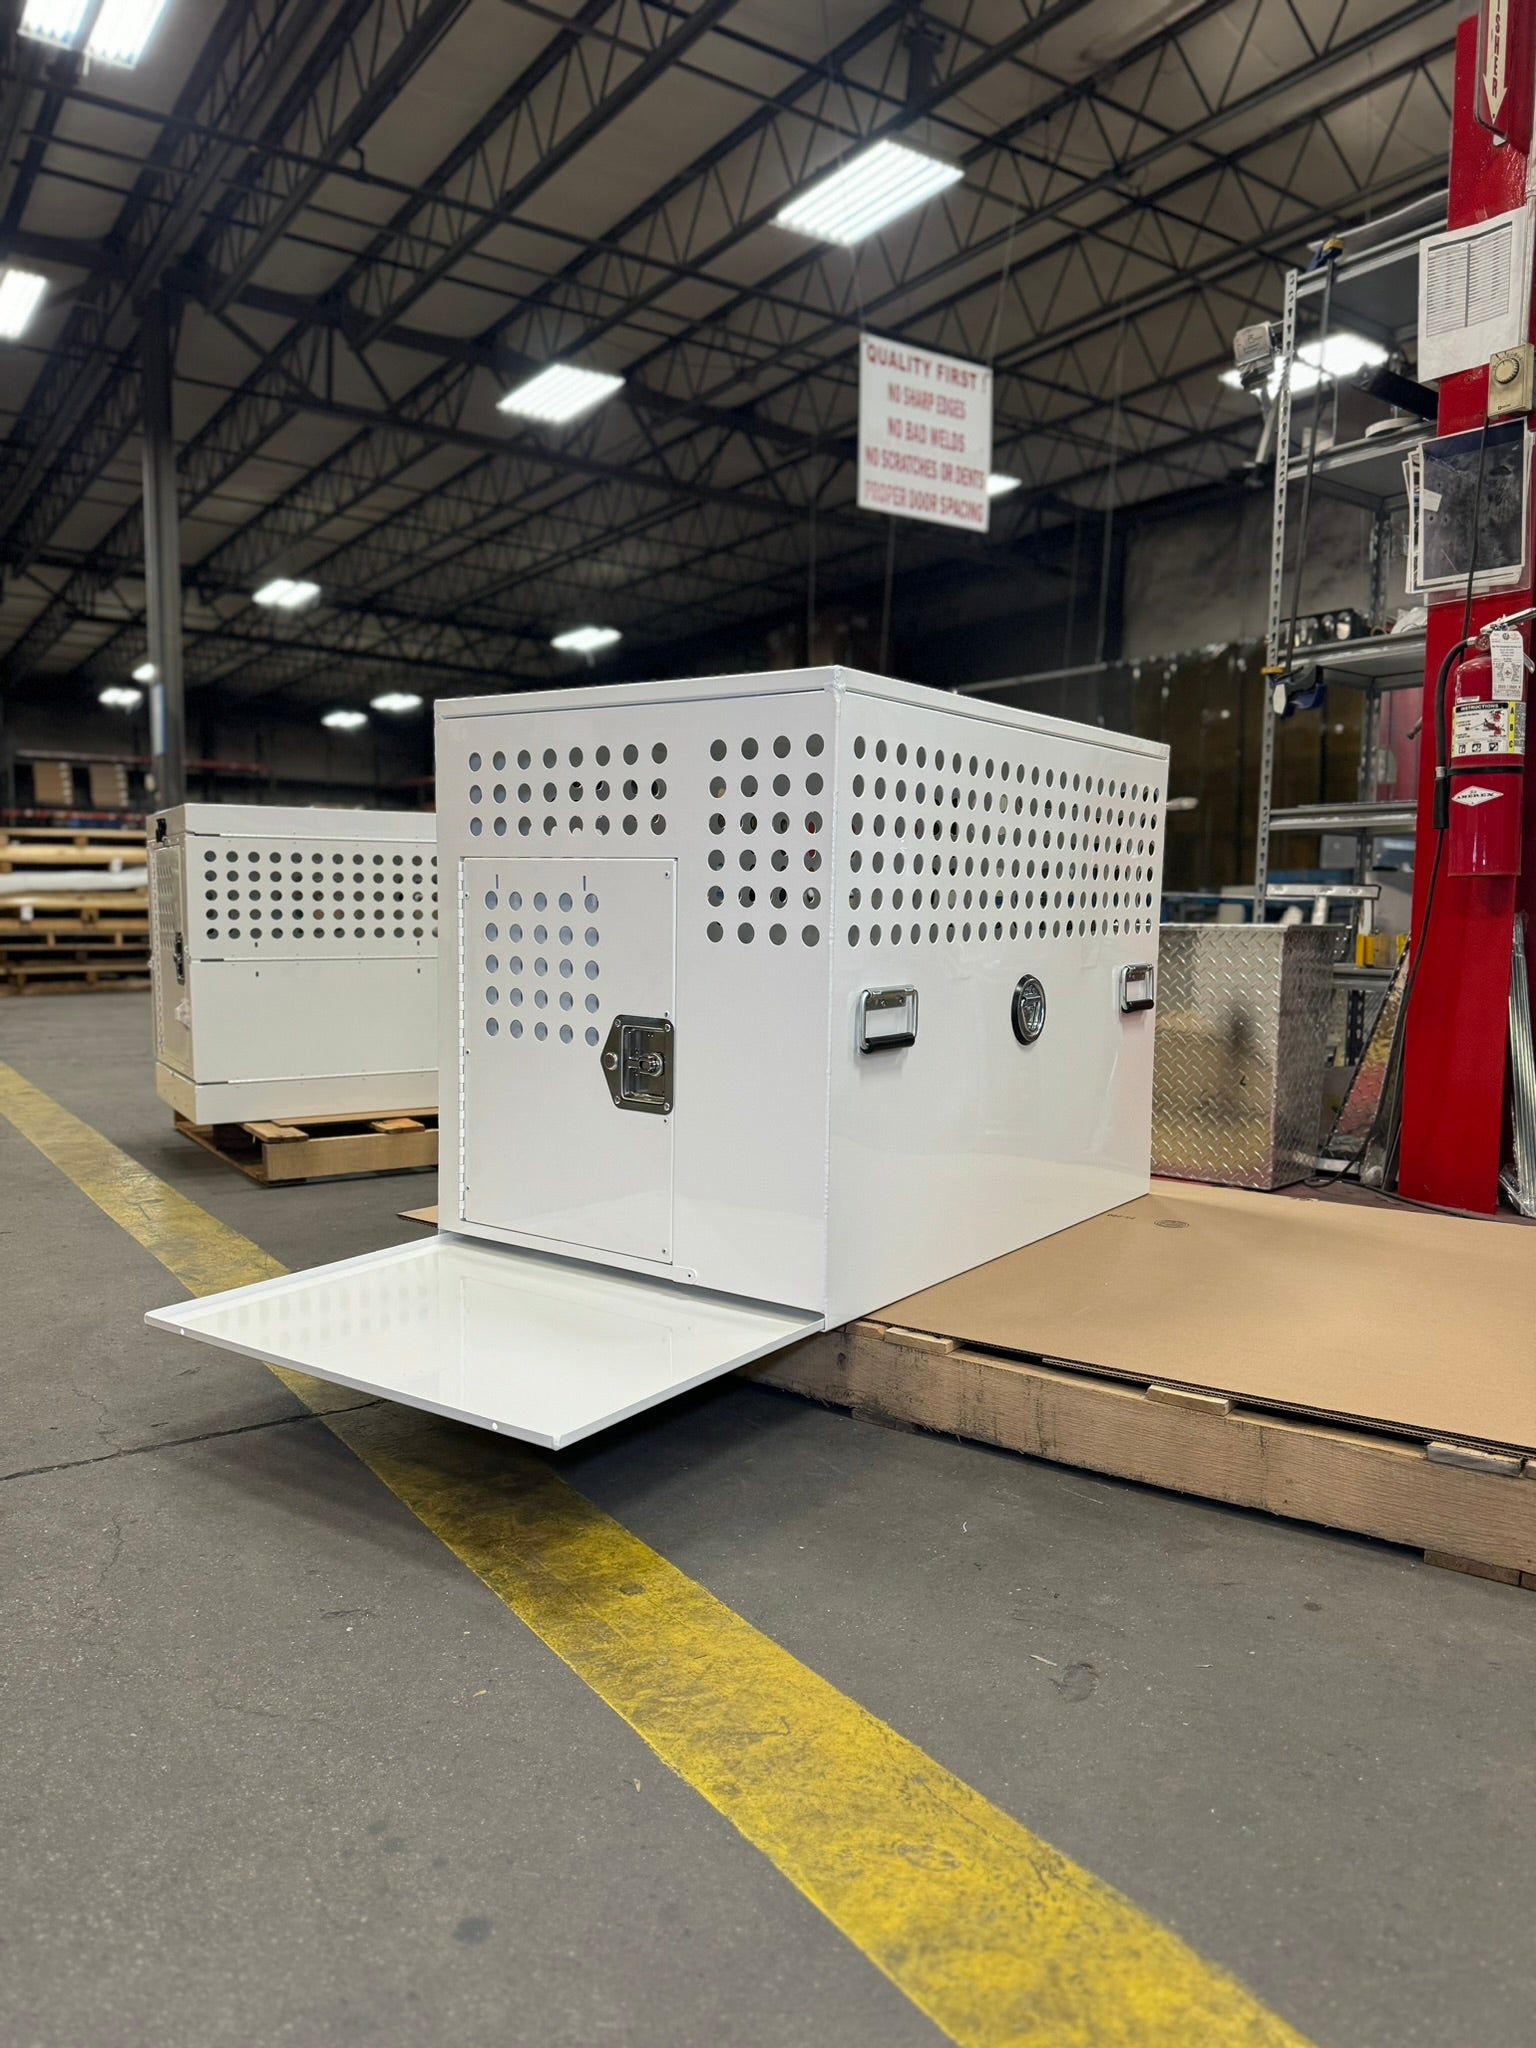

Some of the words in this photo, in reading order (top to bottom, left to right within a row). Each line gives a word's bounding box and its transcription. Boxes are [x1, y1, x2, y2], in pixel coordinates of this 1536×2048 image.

[866, 343, 932, 378] QUALITY
[936, 363, 977, 392] FIRST
[887, 381, 900, 404] NO
[904, 386, 934, 412] SHARP
[936, 394, 966, 421] EDGES
[887, 416, 902, 439] NO
[905, 420, 928, 445] BAD
[930, 426, 966, 454] WELDS
[865, 445, 879, 467] NO
[881, 448, 937, 480] SCRATCHES
[941, 461, 953, 482] OR
[956, 465, 985, 491] DENTS
[909, 488, 937, 513] DOOR
[940, 495, 984, 524] SPACING
[1509, 723, 1514, 732] B
[1510, 706, 1514, 715] A
[1508, 739, 1513, 748] C
